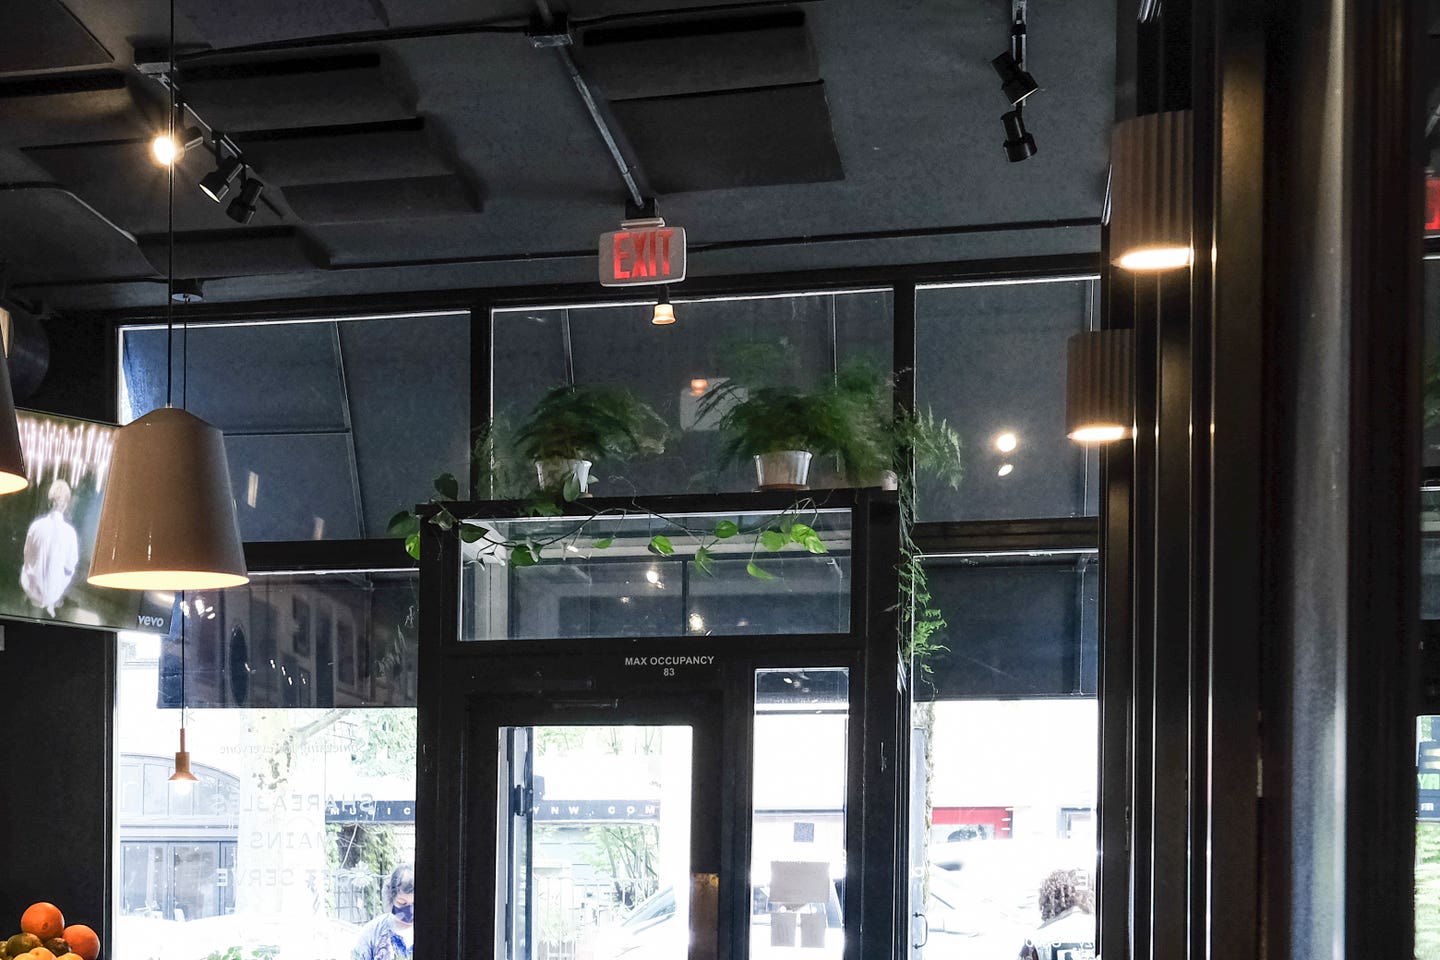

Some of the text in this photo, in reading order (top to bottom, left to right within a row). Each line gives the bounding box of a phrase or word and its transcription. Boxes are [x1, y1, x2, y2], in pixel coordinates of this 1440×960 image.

[614, 230, 673, 279] EXIT
[138, 616, 164, 627] vevo
[625, 656, 715, 666] MAX OCCUPANCY
[663, 668, 675, 676] 83
